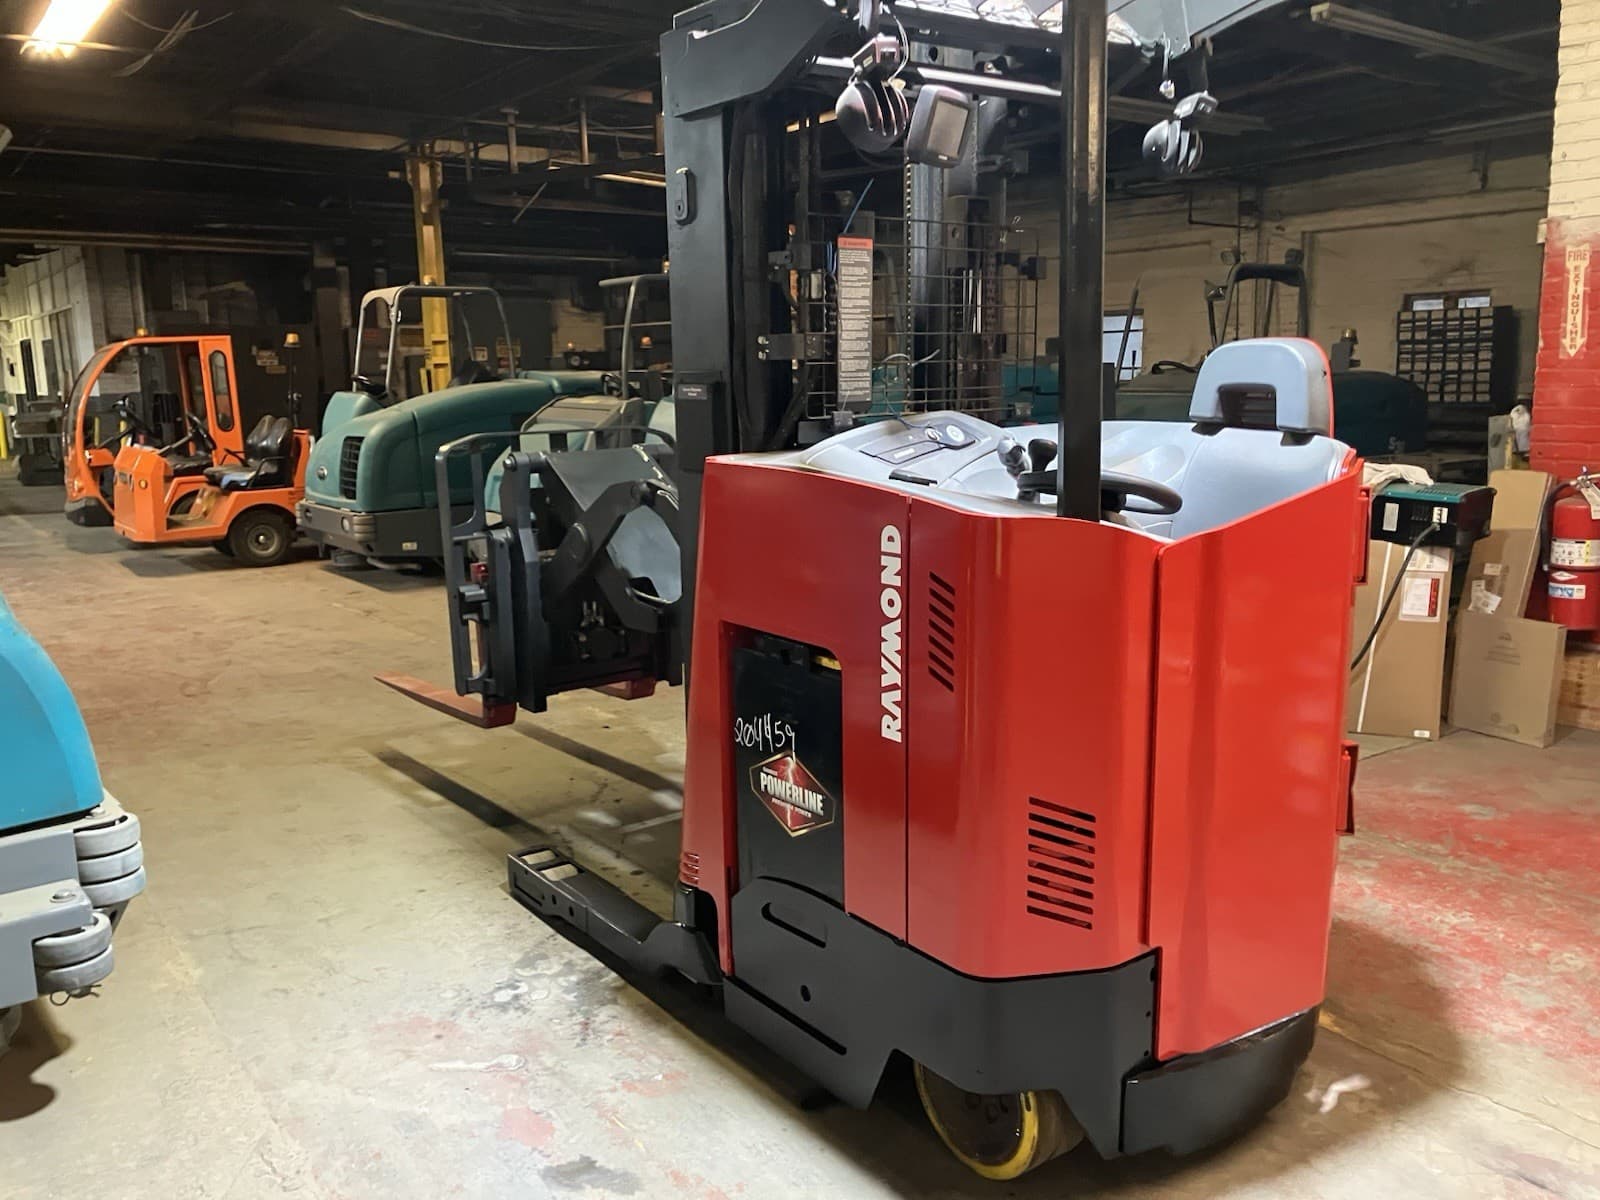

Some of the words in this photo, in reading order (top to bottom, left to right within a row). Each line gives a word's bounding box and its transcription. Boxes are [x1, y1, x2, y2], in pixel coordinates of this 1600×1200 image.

[1567, 250, 1588, 262] FIRE
[1569, 264, 1580, 350] EXTINGUISHER
[880, 524, 902, 743] RAYMOND
[760, 771, 824, 816] POWERLINE
